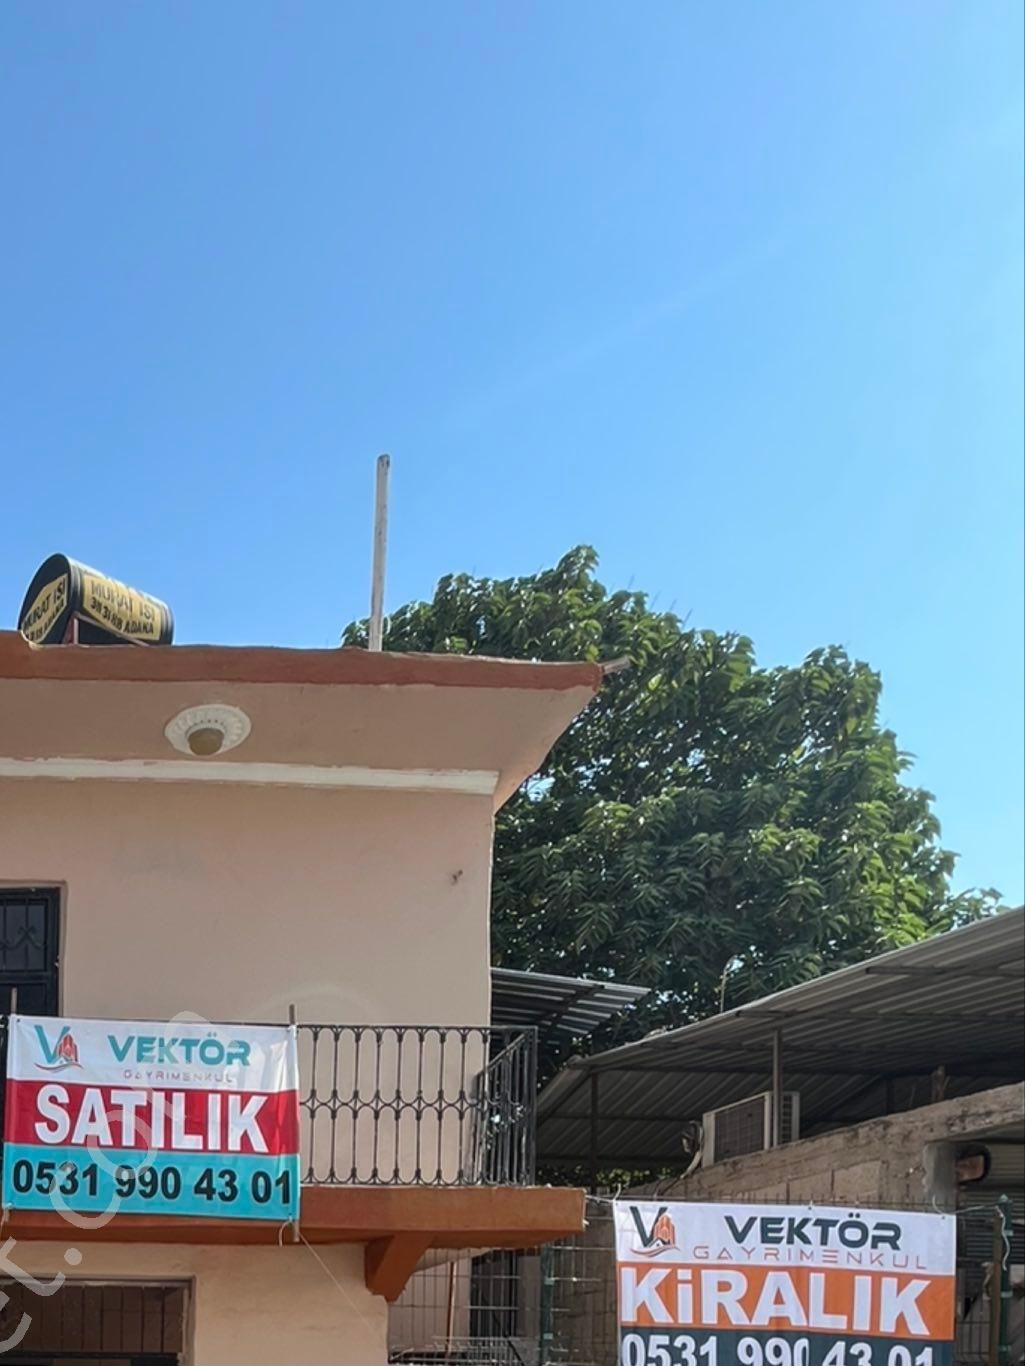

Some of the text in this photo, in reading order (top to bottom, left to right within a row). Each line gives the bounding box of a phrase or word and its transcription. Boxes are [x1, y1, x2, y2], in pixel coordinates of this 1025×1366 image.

[107, 1032, 251, 1066] VEKTÖR
[34, 1084, 269, 1153] SATILIK
[13, 1160, 290, 1204] 0531 990 43 01
[724, 1212, 902, 1250] VEKTÖR
[693, 1246, 927, 1270] GAYRIMENKUL
